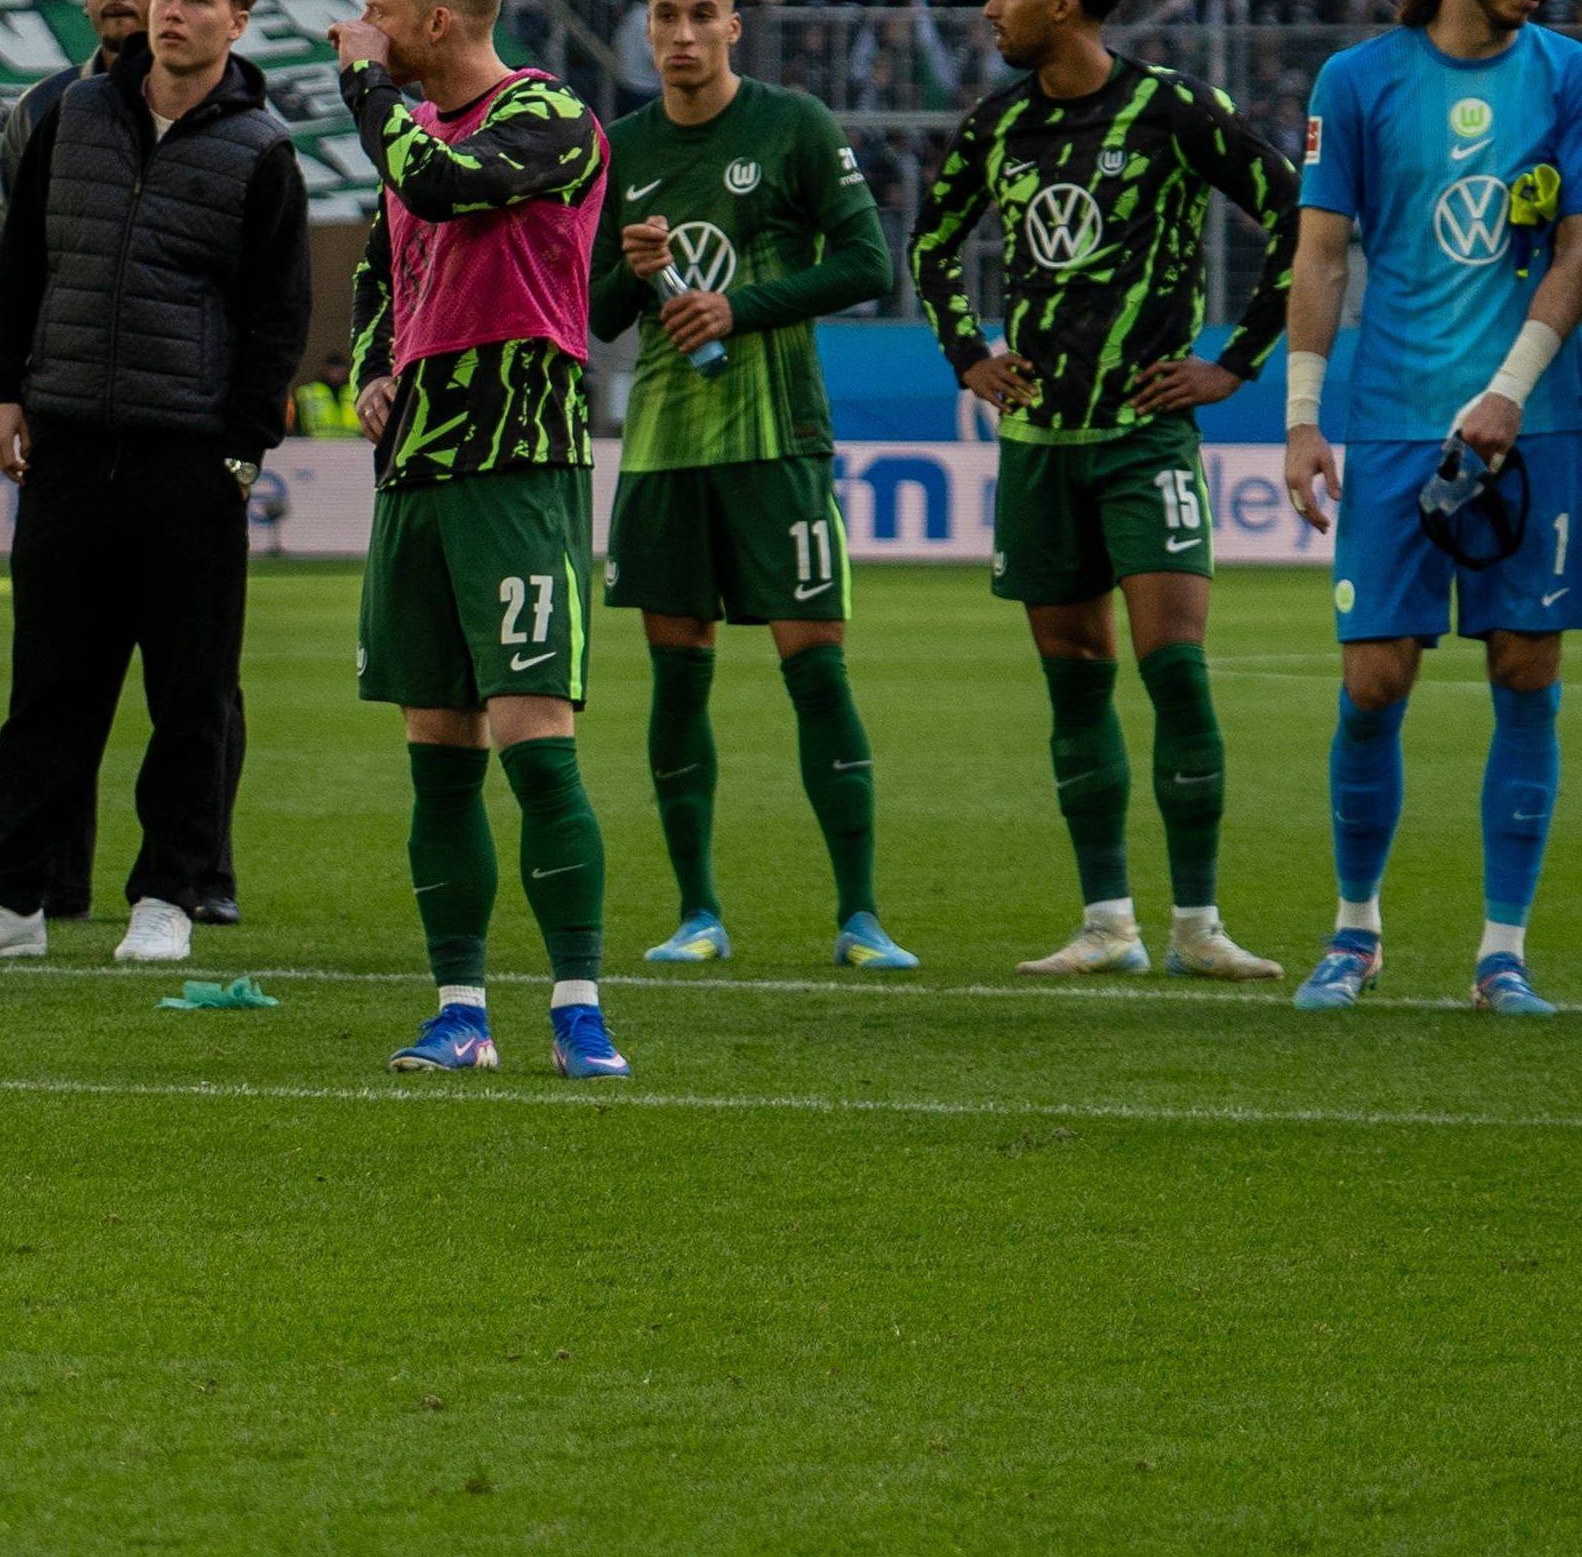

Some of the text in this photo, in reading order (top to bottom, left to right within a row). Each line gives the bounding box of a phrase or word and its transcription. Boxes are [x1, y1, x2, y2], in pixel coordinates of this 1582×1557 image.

[1155, 469, 1201, 530] 15
[789, 520, 833, 583] 11
[1552, 512, 1570, 575] 1
[499, 574, 554, 645] 27
